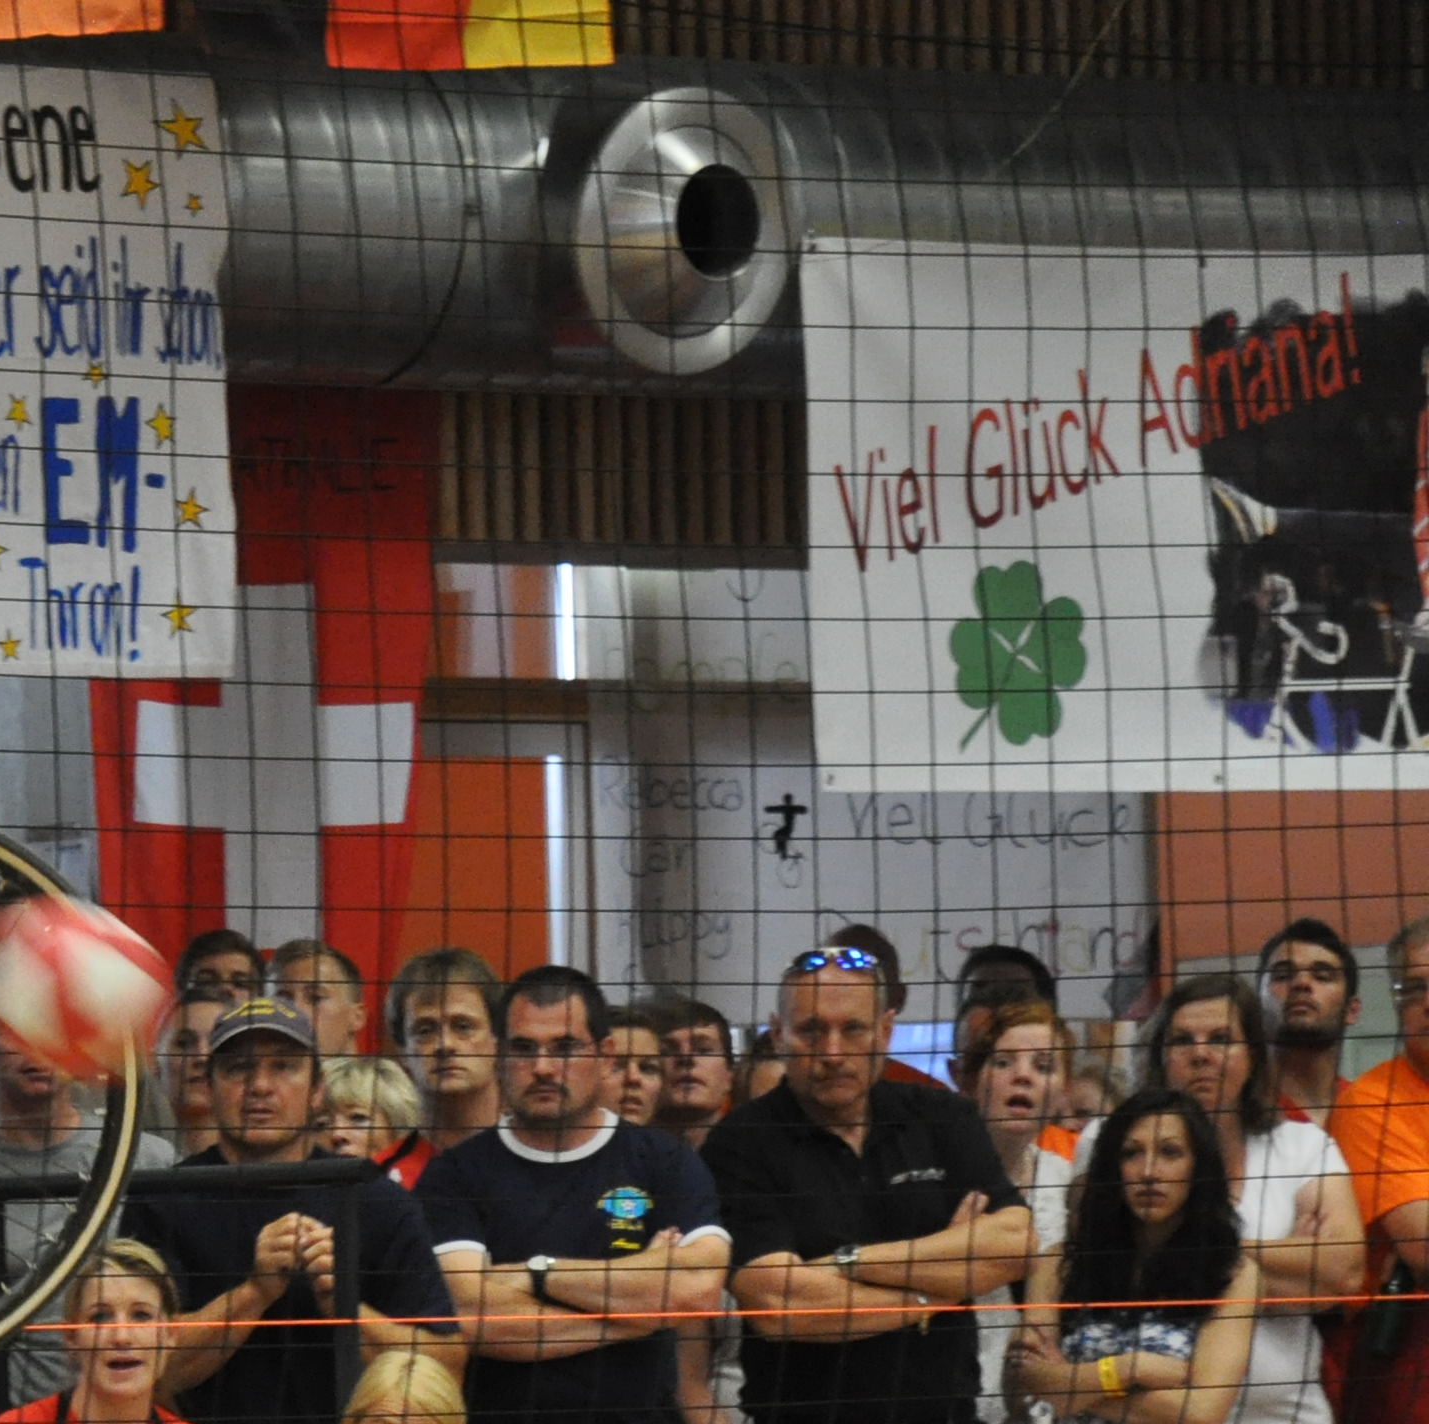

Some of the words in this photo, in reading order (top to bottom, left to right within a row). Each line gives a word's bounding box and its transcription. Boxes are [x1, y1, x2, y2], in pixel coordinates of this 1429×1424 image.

[834, 425, 941, 573] Viel
[964, 368, 1123, 529] Glück
[1137, 271, 1364, 468] Adriana!
